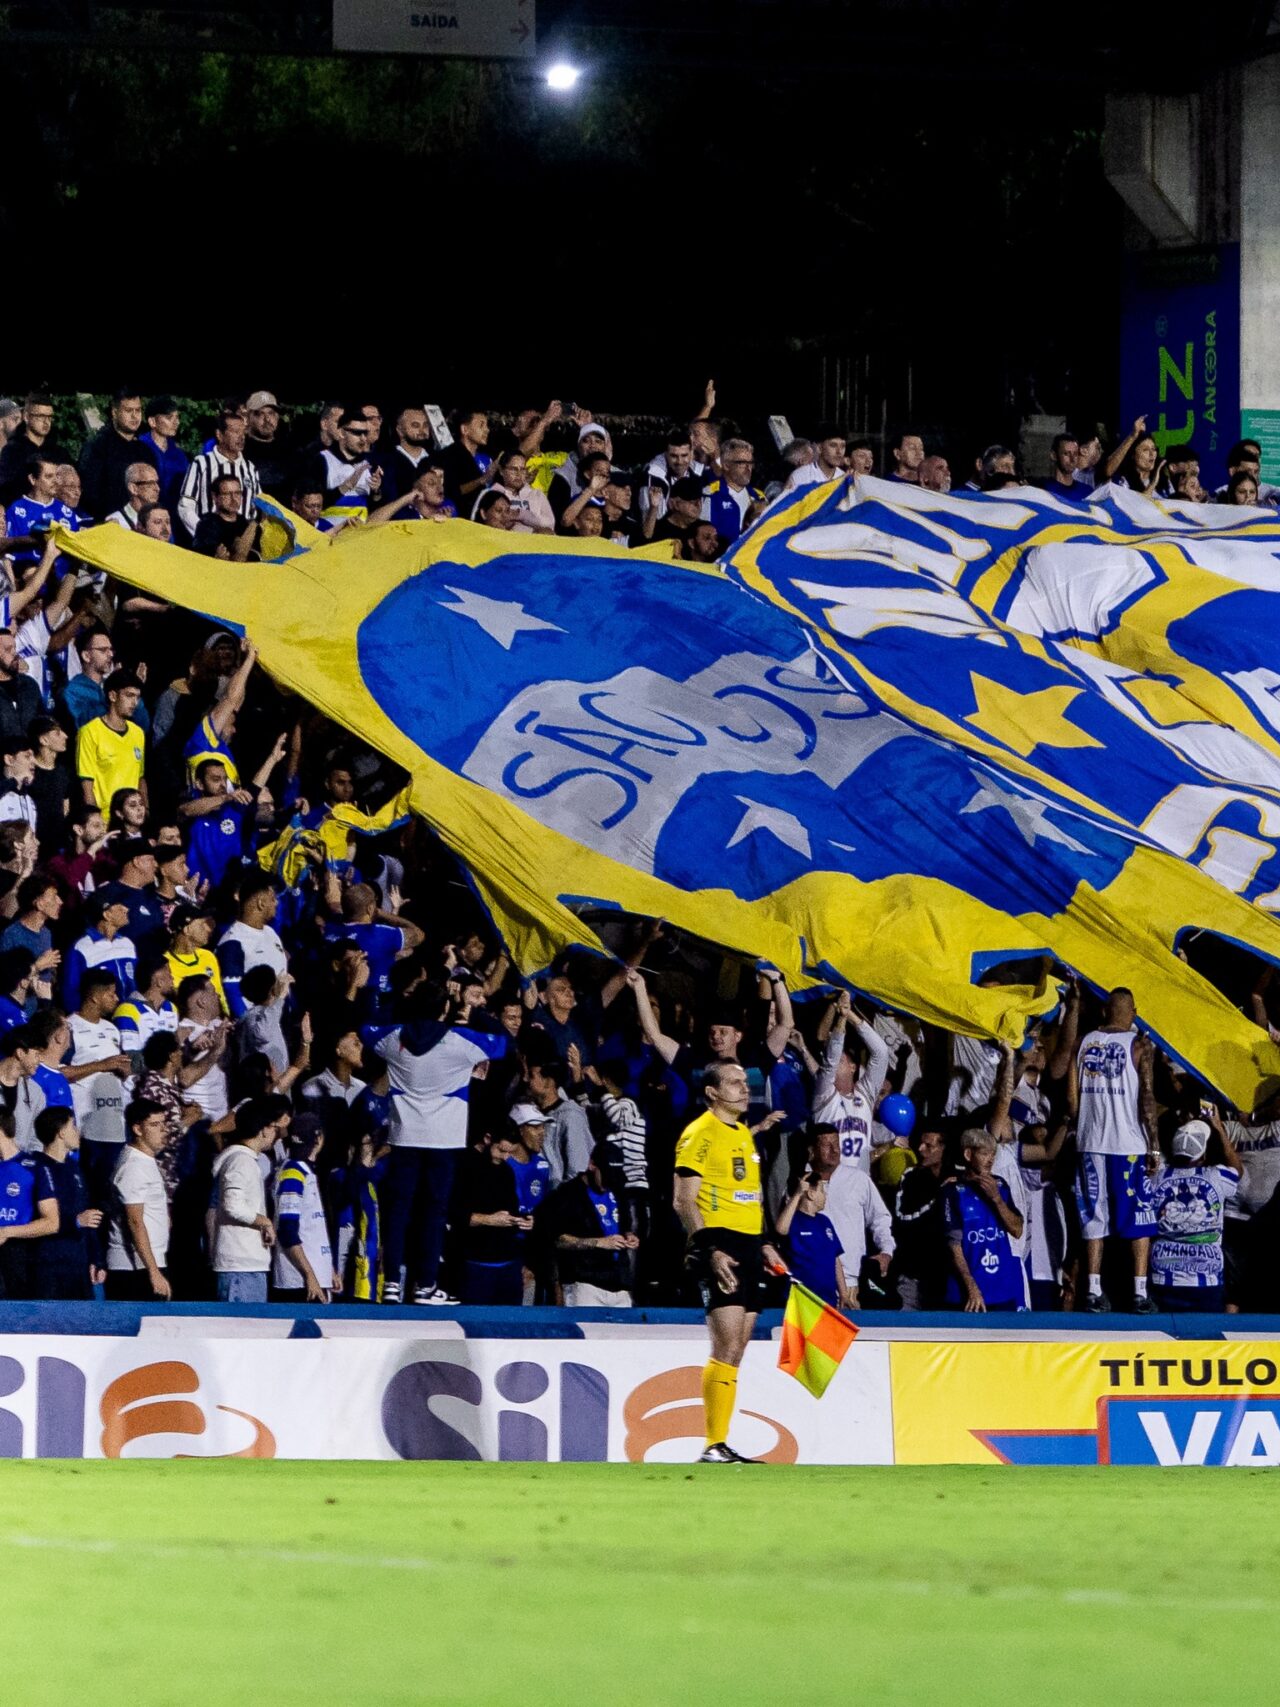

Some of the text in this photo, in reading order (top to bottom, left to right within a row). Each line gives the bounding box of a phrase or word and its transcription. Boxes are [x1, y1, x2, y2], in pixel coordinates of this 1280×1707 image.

[1203, 310, 1217, 424] ANCORA
[842, 1138, 864, 1158] 87
[1099, 1352, 1278, 1387] TÍTULO
